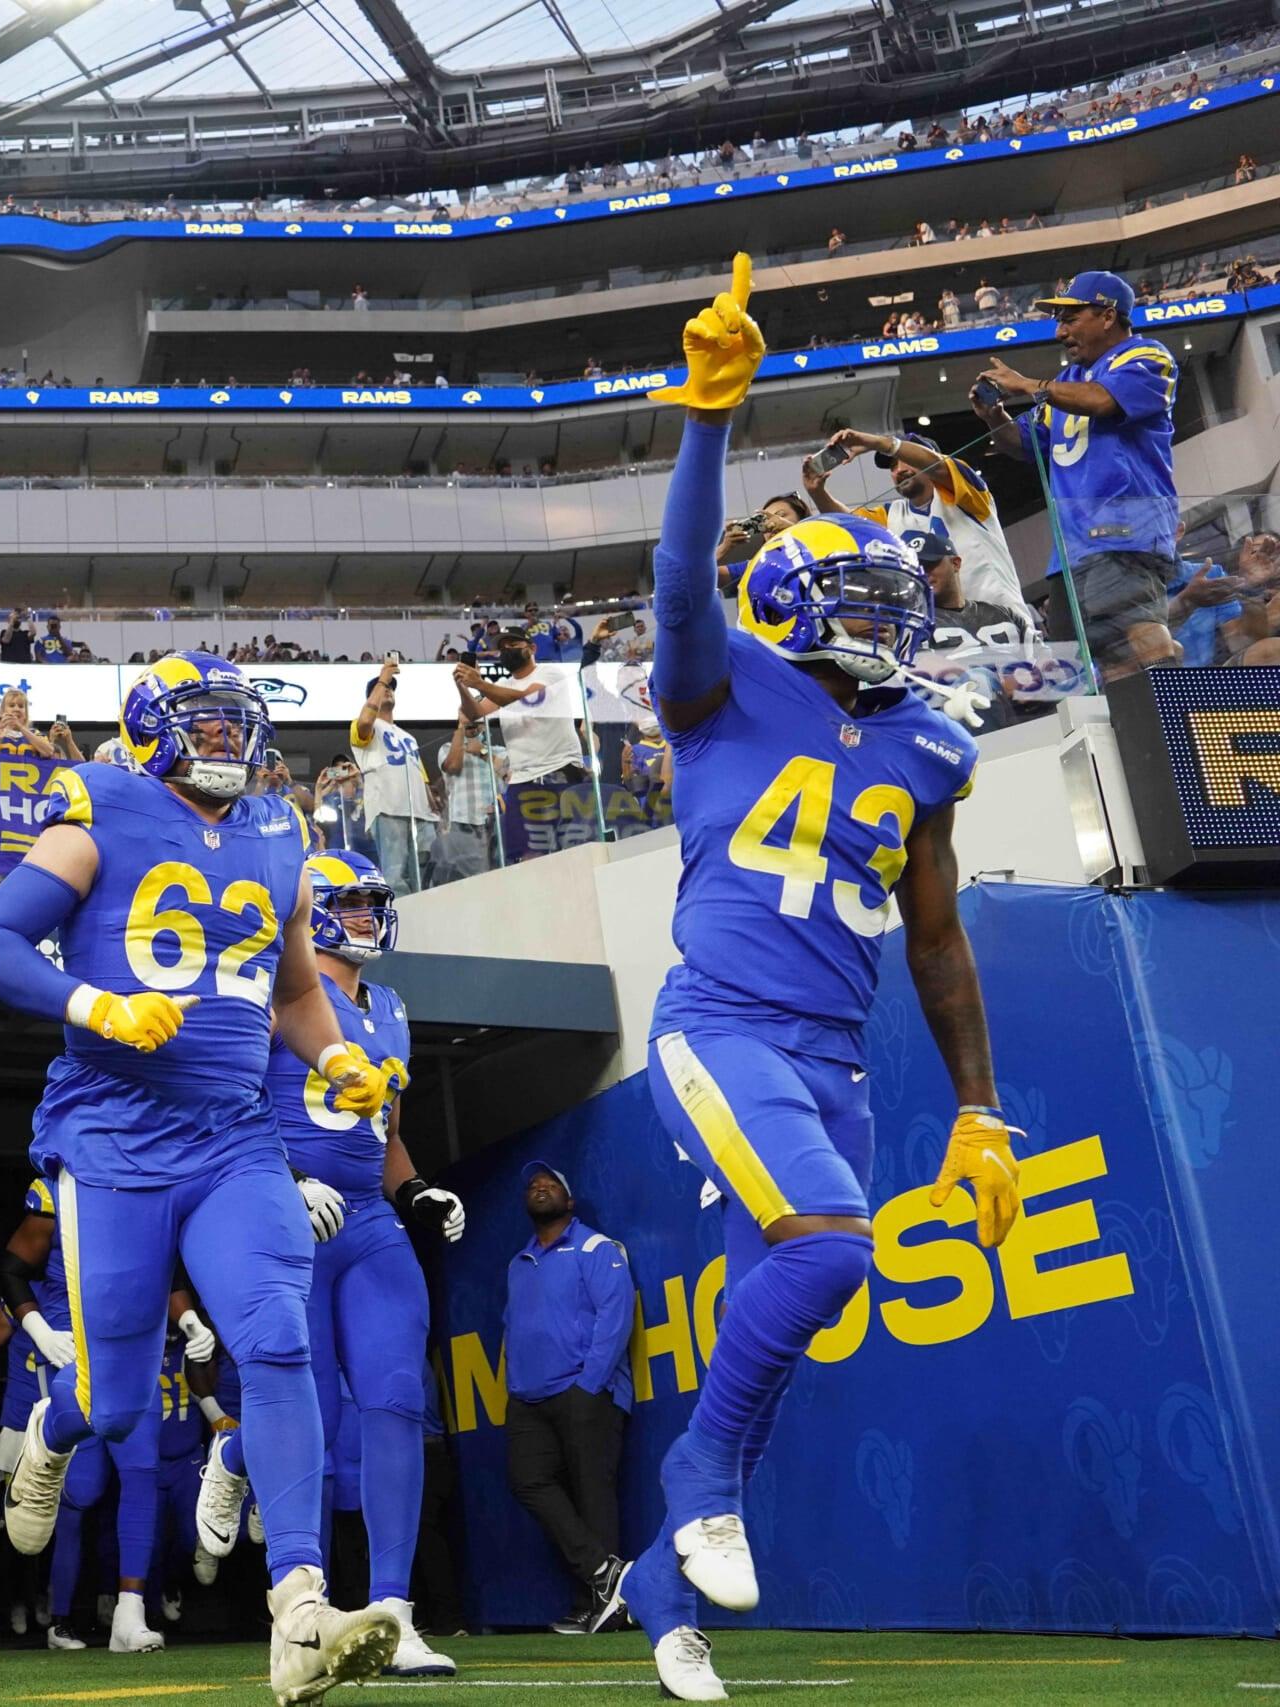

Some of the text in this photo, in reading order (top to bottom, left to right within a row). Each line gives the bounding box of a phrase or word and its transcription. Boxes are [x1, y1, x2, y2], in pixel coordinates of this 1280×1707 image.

[1065, 117, 1138, 142] RAMS
[832, 157, 898, 178] RAMS
[609, 192, 671, 211] RAMS
[185, 223, 244, 235] RAMS
[394, 223, 453, 235] RAMS
[1144, 298, 1227, 322] RAMS
[862, 337, 940, 359] RAMS
[594, 372, 668, 395] RAMS
[89, 390, 160, 405] RAMS
[341, 390, 412, 405] RAMS
[914, 735, 961, 766] RAMS
[0, 762, 72, 796] RA
[261, 822, 291, 833] RAMS
[728, 755, 915, 937] 43
[125, 861, 278, 1010] 62
